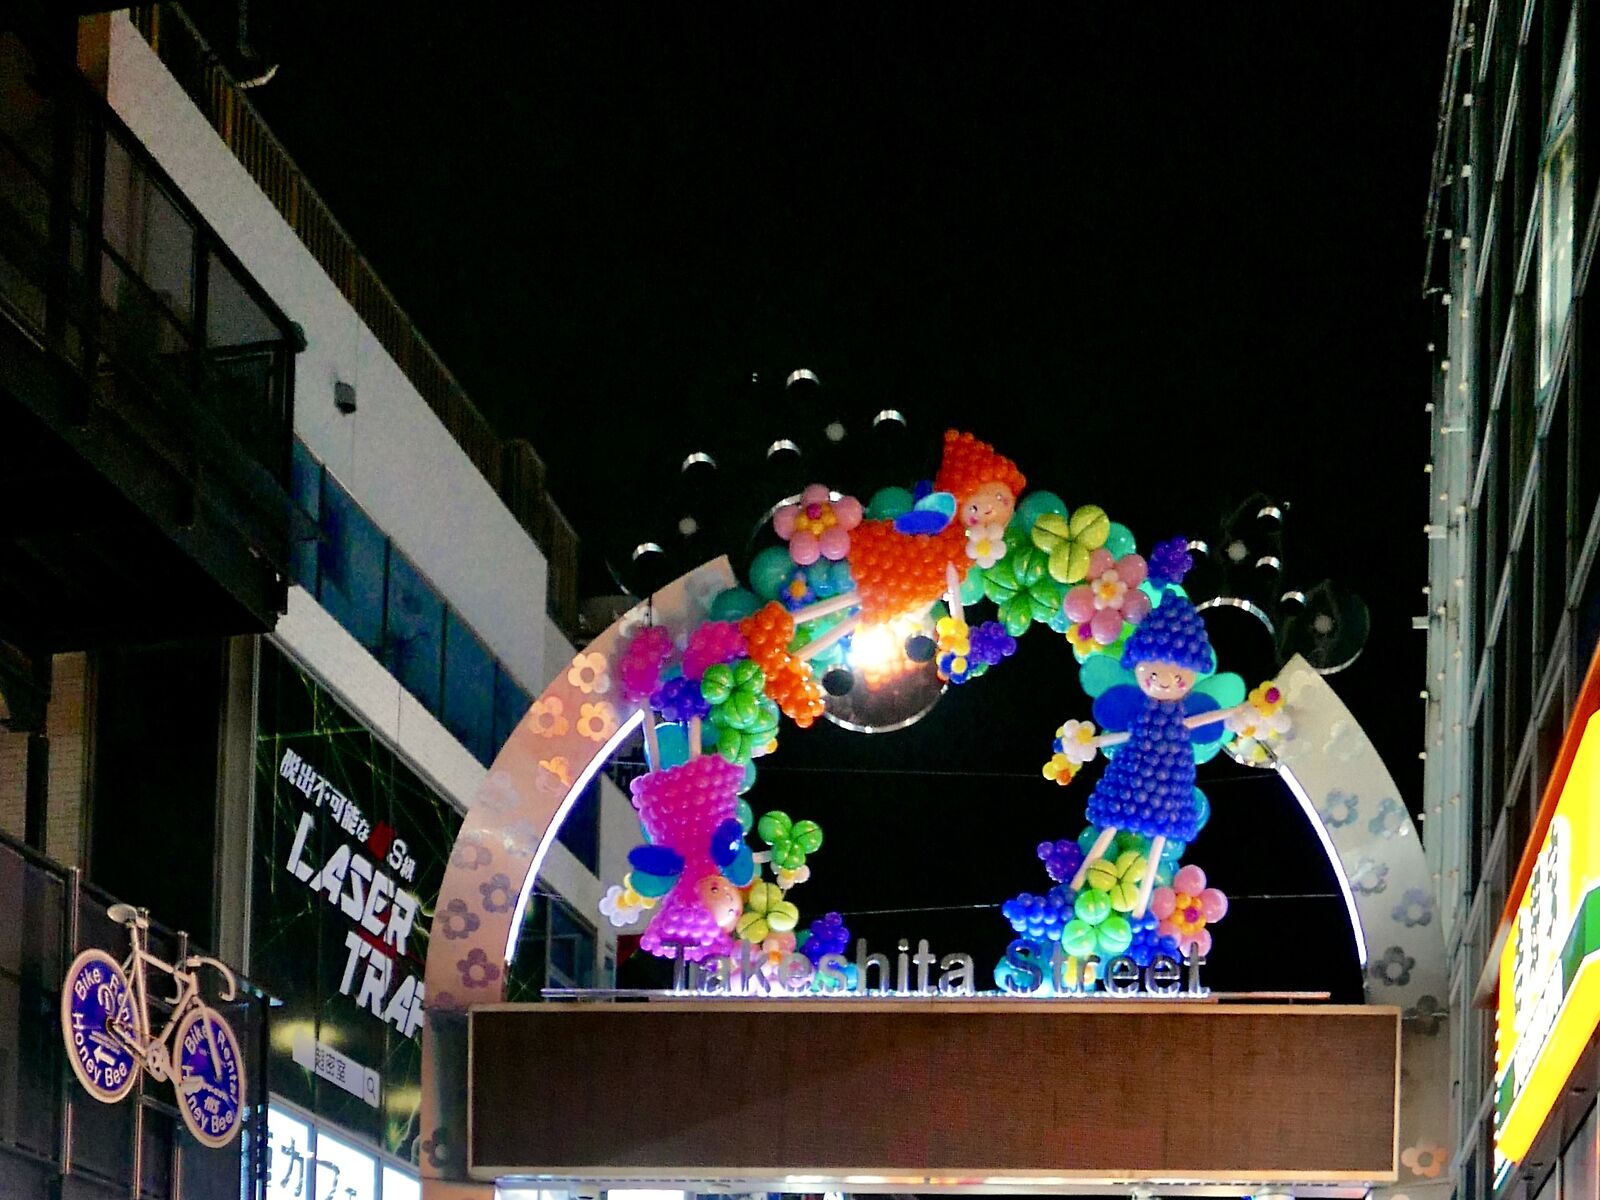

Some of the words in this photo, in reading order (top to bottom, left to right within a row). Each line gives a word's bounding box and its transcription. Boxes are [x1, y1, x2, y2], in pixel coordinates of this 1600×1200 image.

[286, 811, 419, 956] LASER
[75, 967, 101, 1001] Bike
[660, 938, 976, 997] Takeshita
[1002, 939, 1207, 997] Street
[71, 1012, 102, 1086] Honey
[104, 1062, 127, 1087] Bee
[184, 1025, 208, 1056] Bike
[216, 1029, 239, 1105] Rental
[211, 1109, 233, 1133] Bee
